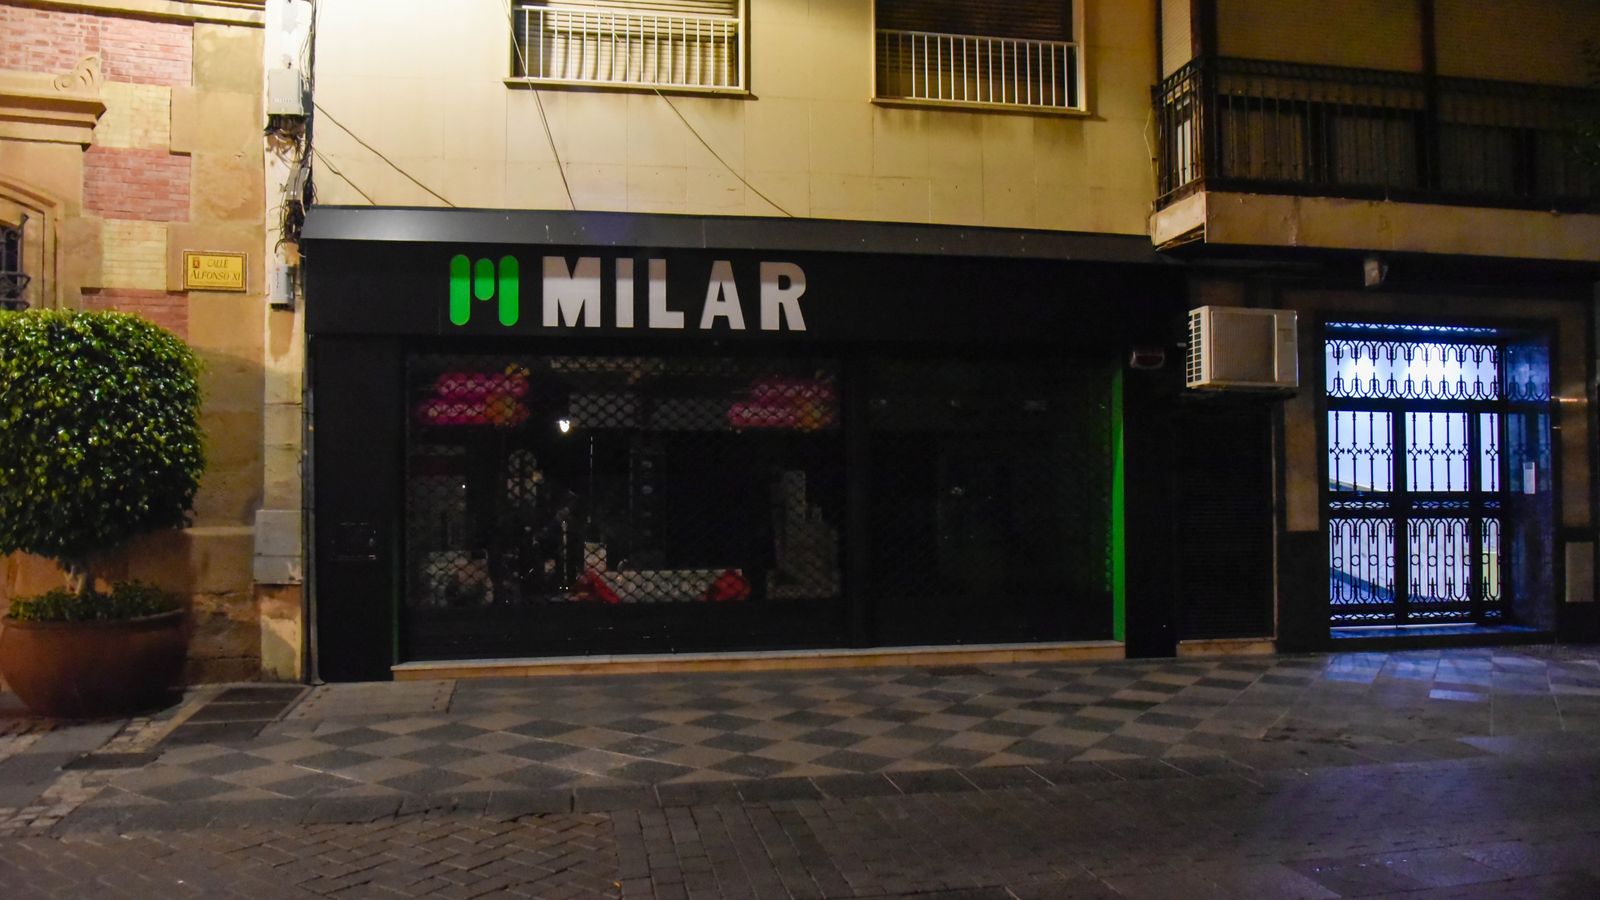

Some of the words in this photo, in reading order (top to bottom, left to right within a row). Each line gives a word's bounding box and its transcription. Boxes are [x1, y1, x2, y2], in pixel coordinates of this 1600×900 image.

[207, 258, 229, 269] CALLE
[190, 269, 230, 281] ALFONSO
[542, 256, 807, 331] MILAR
